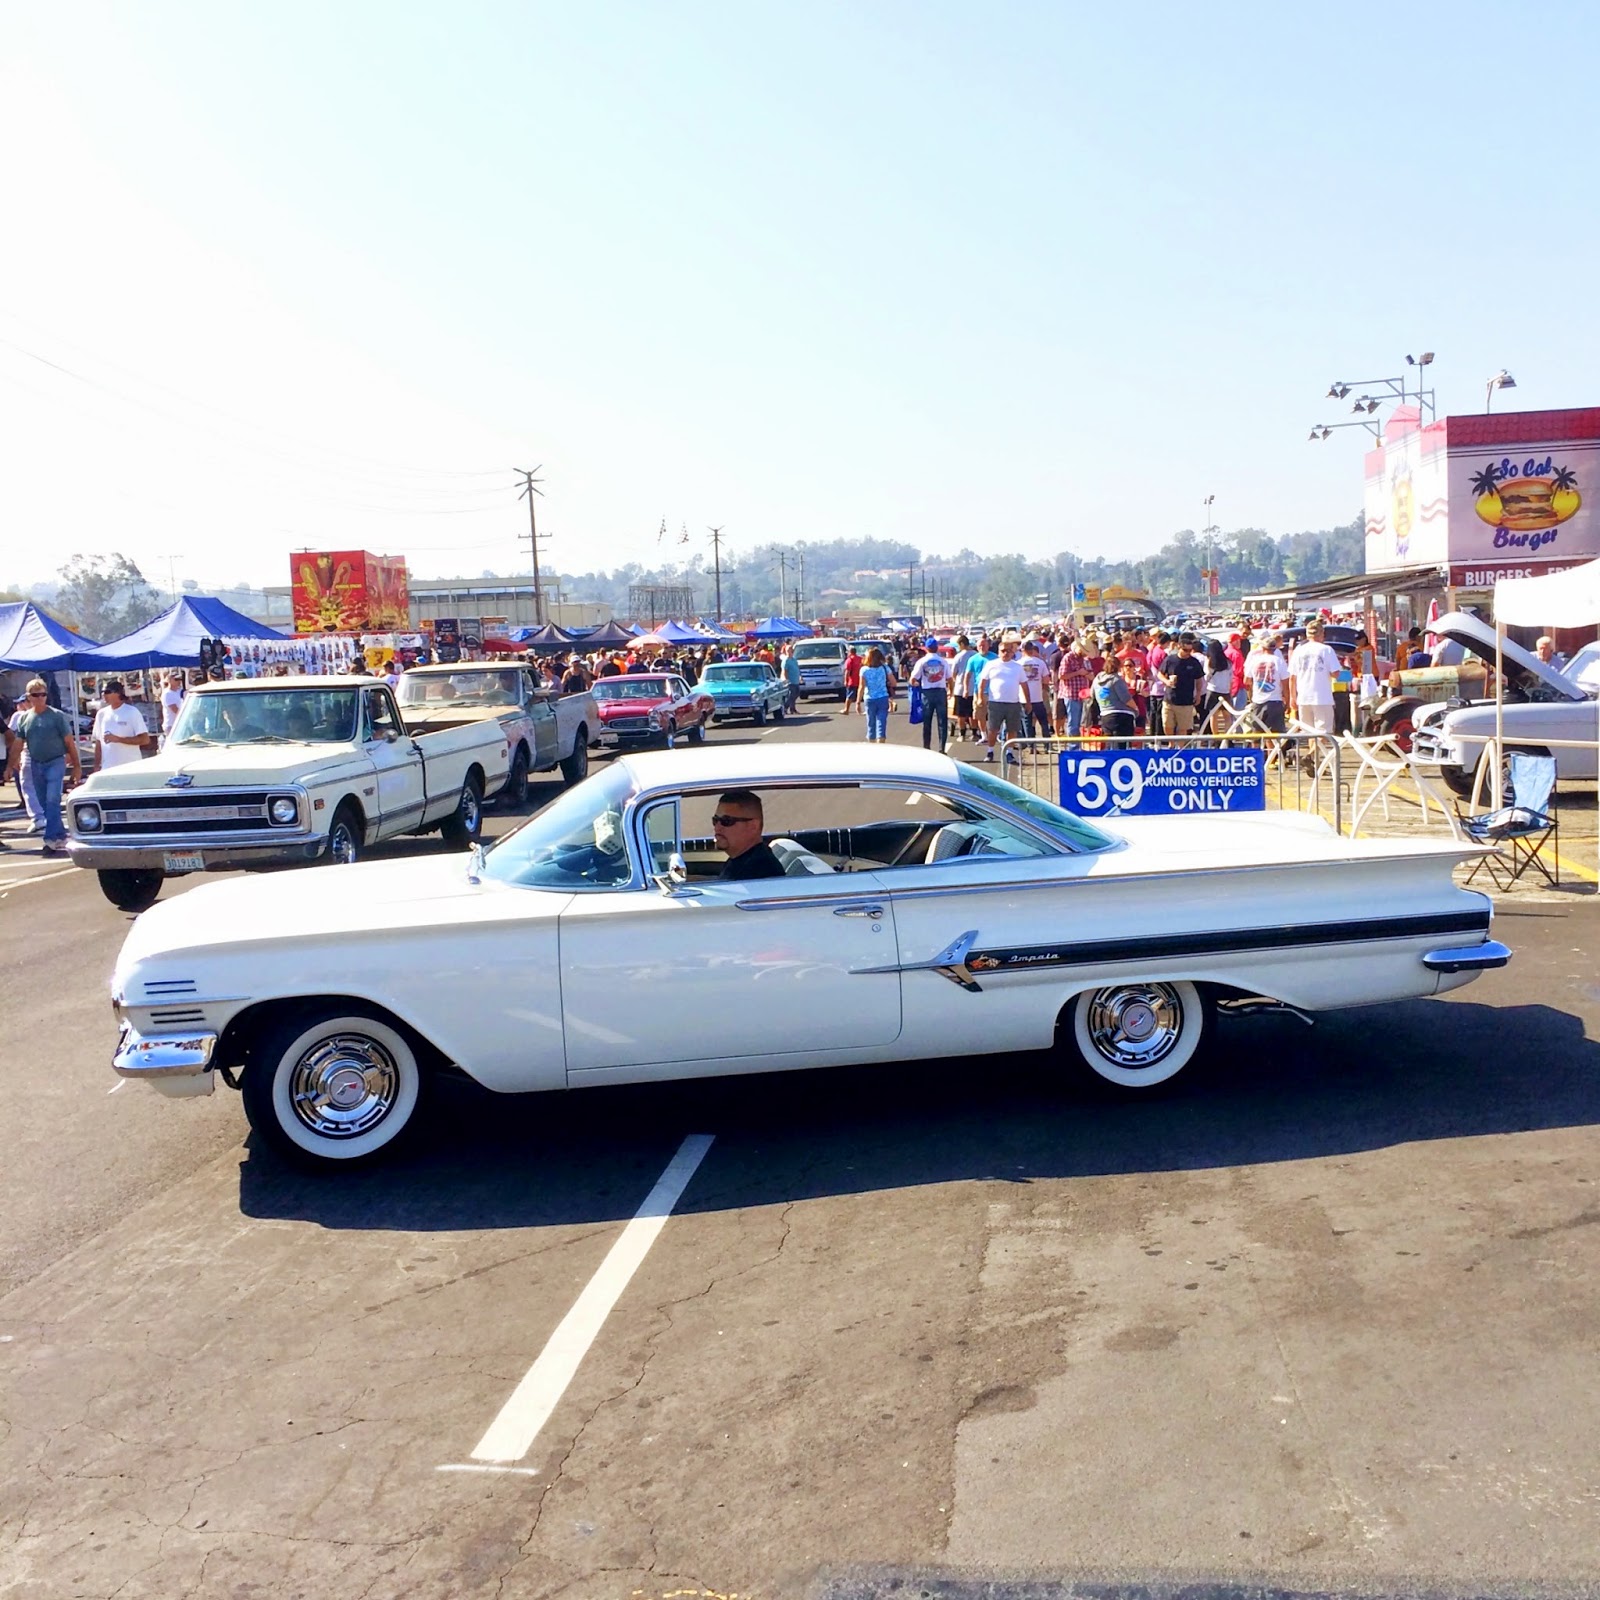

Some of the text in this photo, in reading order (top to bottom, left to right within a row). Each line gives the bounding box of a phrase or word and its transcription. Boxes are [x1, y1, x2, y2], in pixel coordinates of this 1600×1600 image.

[1500, 456, 1552, 477] So Cal
[1493, 527, 1558, 551] Burger
[1465, 568, 1532, 586] BURGERS
[1146, 757, 1257, 774] AND OLDER
[1067, 758, 1143, 809] '59
[1145, 776, 1258, 787] RUNNING VEHILCES
[1169, 789, 1233, 810] ONLY
[1008, 953, 1060, 963] Impala
